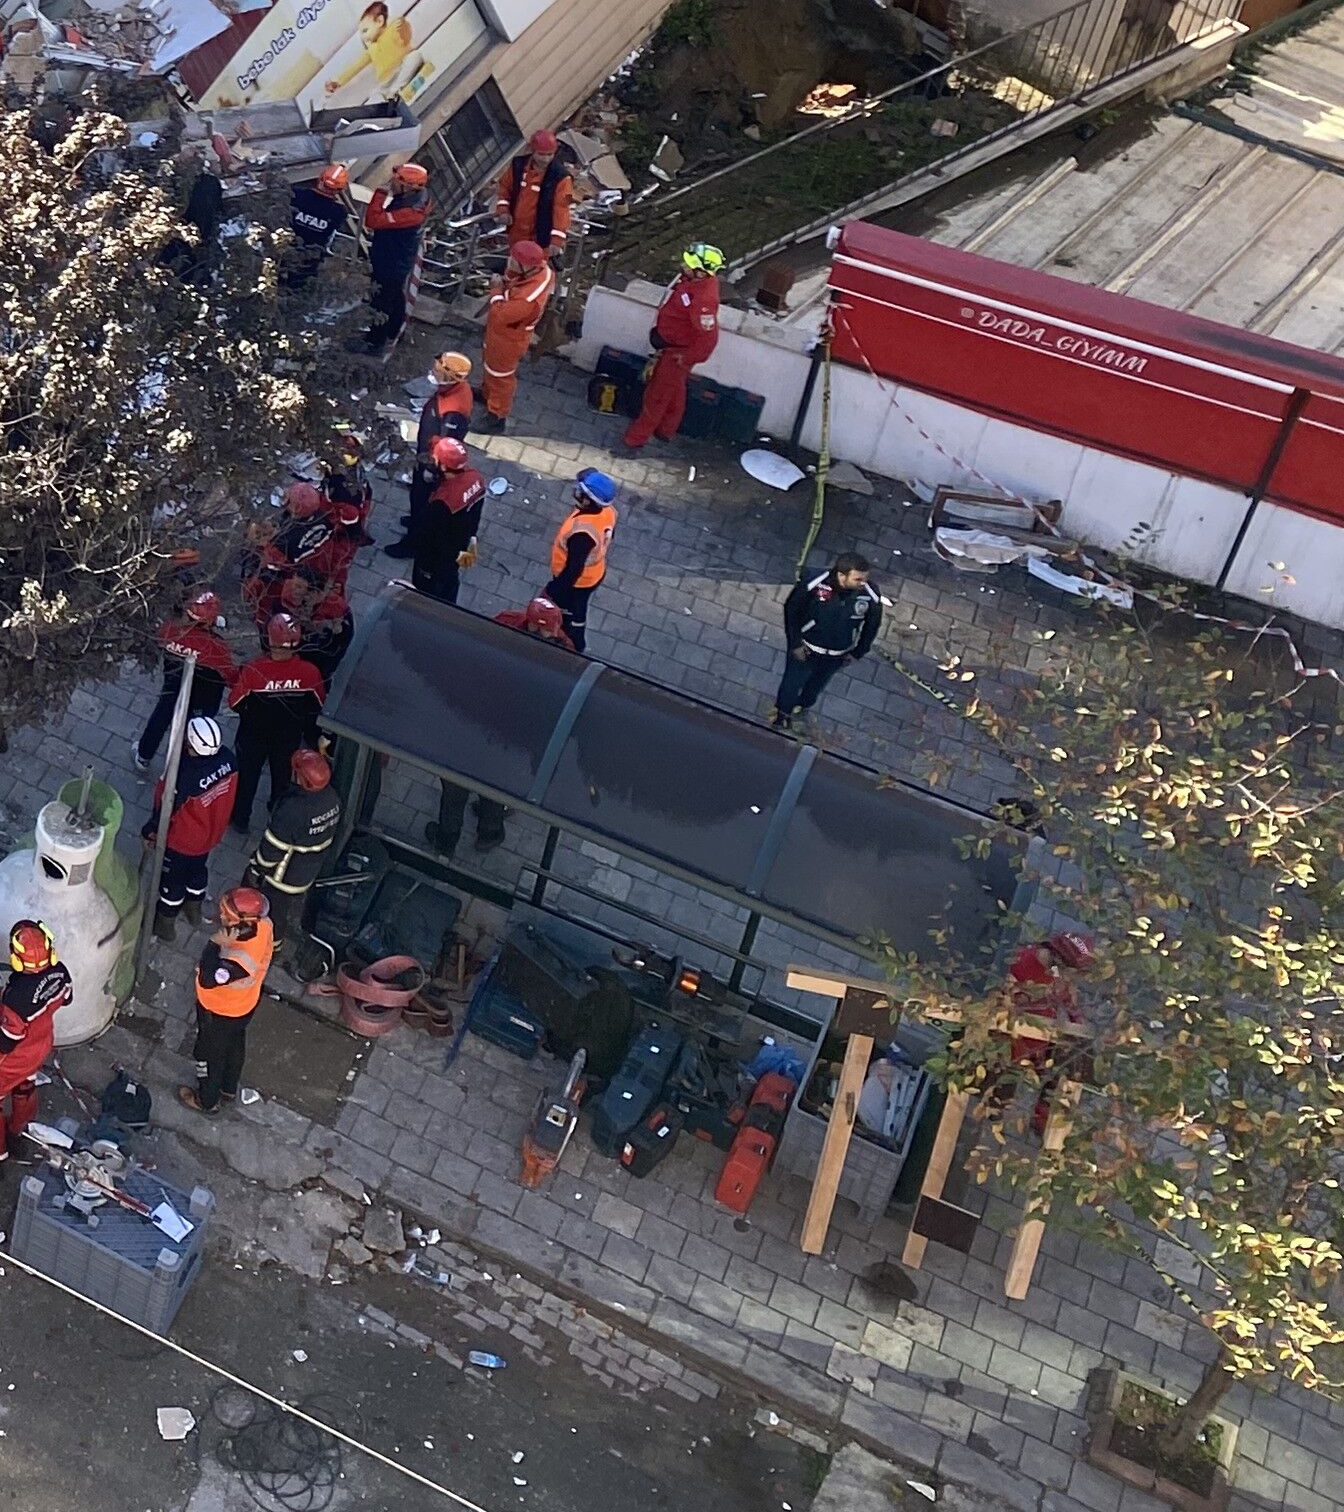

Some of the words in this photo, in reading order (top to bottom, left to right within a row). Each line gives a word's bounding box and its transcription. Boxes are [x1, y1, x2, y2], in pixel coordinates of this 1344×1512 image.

[238, 50, 274, 90] bebe
[271, 26, 297, 55] lak
[296, 212, 328, 229] AFAD
[265, 679, 301, 689] AKAK
